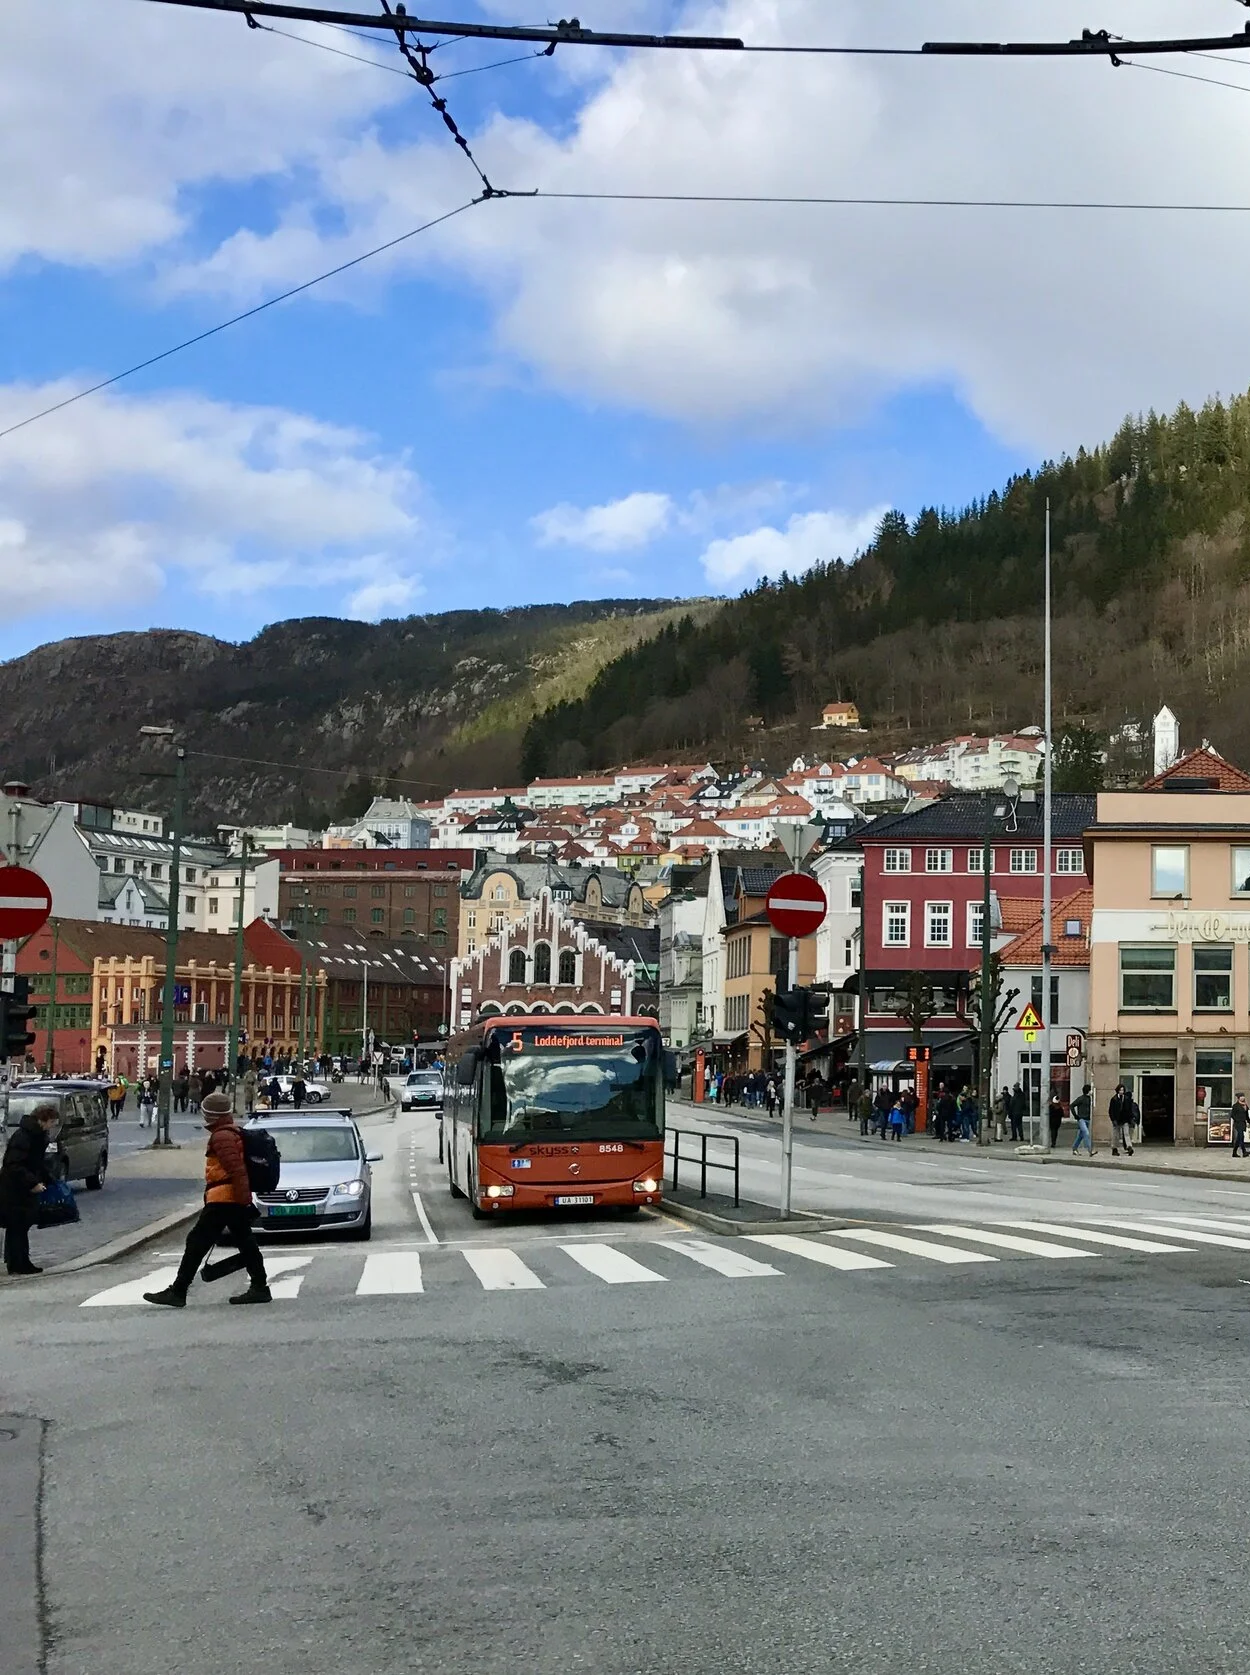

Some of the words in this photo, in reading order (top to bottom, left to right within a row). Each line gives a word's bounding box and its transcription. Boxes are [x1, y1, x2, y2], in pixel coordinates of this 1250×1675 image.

[511, 1032, 523, 1052] 5
[534, 1035, 585, 1049] Loddefjord
[586, 1035, 624, 1046] terminal
[1067, 1036, 1080, 1047] Deli
[529, 1145, 569, 1157] skyss
[599, 1144, 624, 1153] 8548
